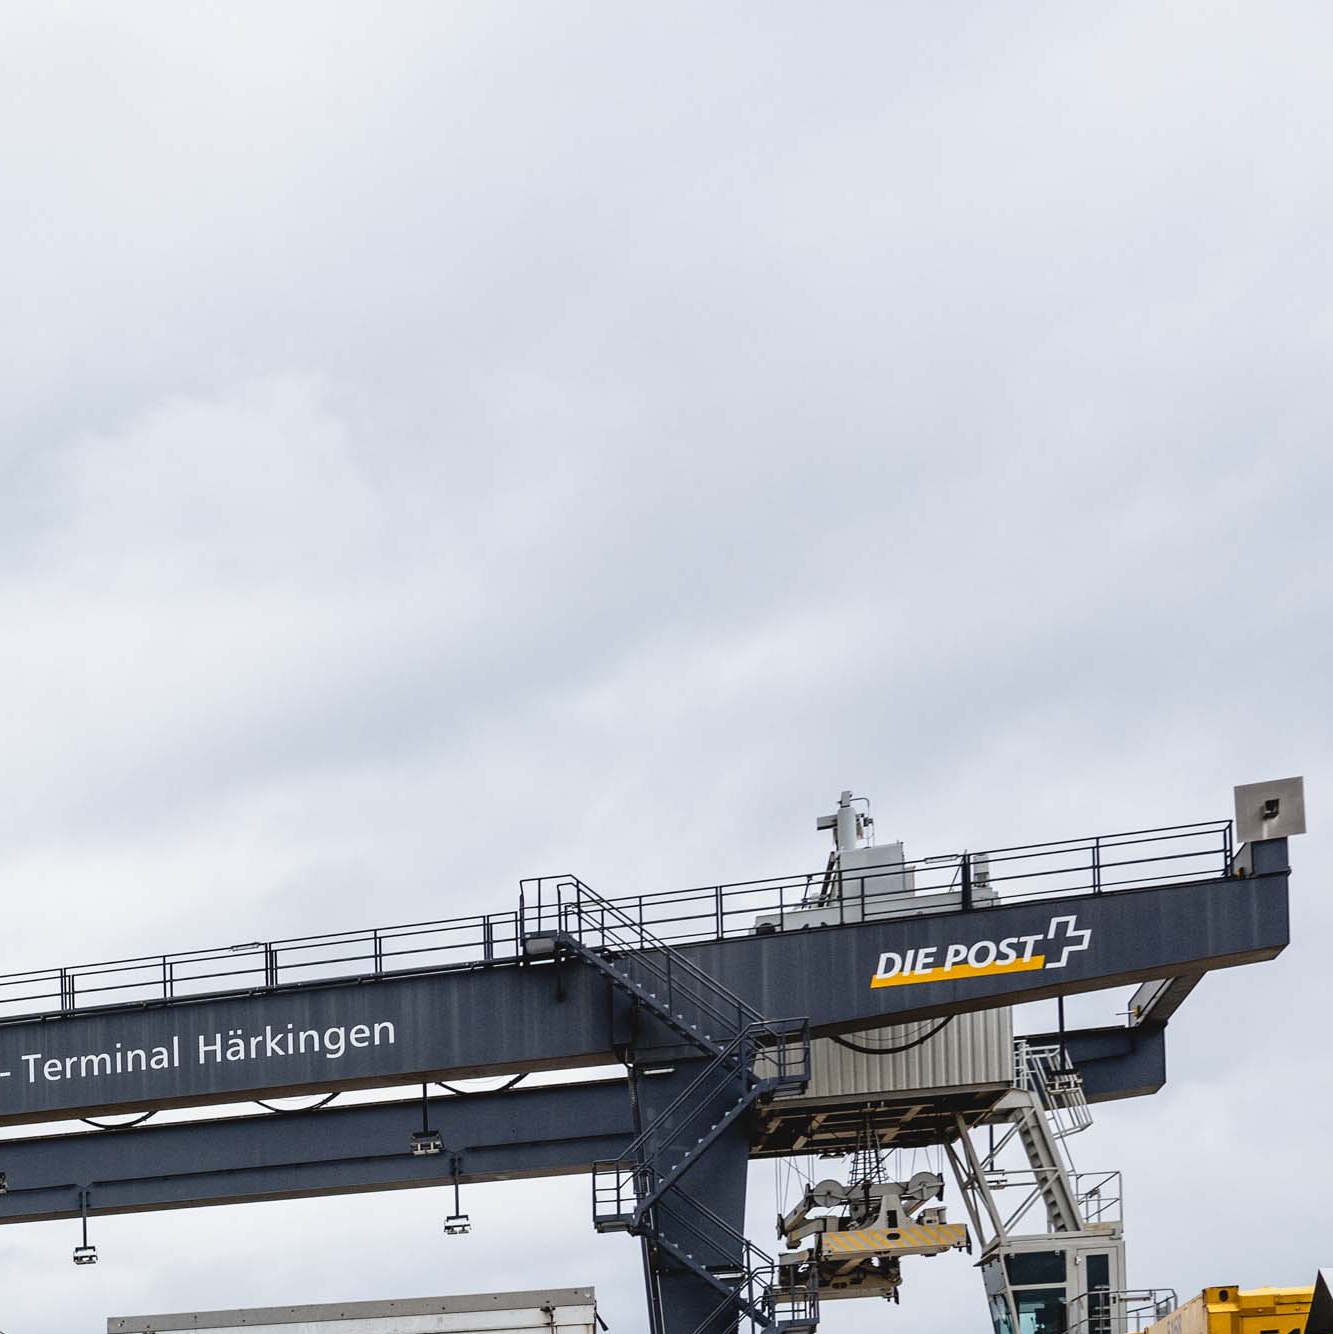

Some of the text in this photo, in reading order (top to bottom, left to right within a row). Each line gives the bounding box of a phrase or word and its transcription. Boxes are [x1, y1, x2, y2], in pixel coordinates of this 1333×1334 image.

[875, 933, 1044, 980] DIE POST
[22, 1035, 179, 1085] Terminal
[198, 1019, 395, 1066] Härkingen
